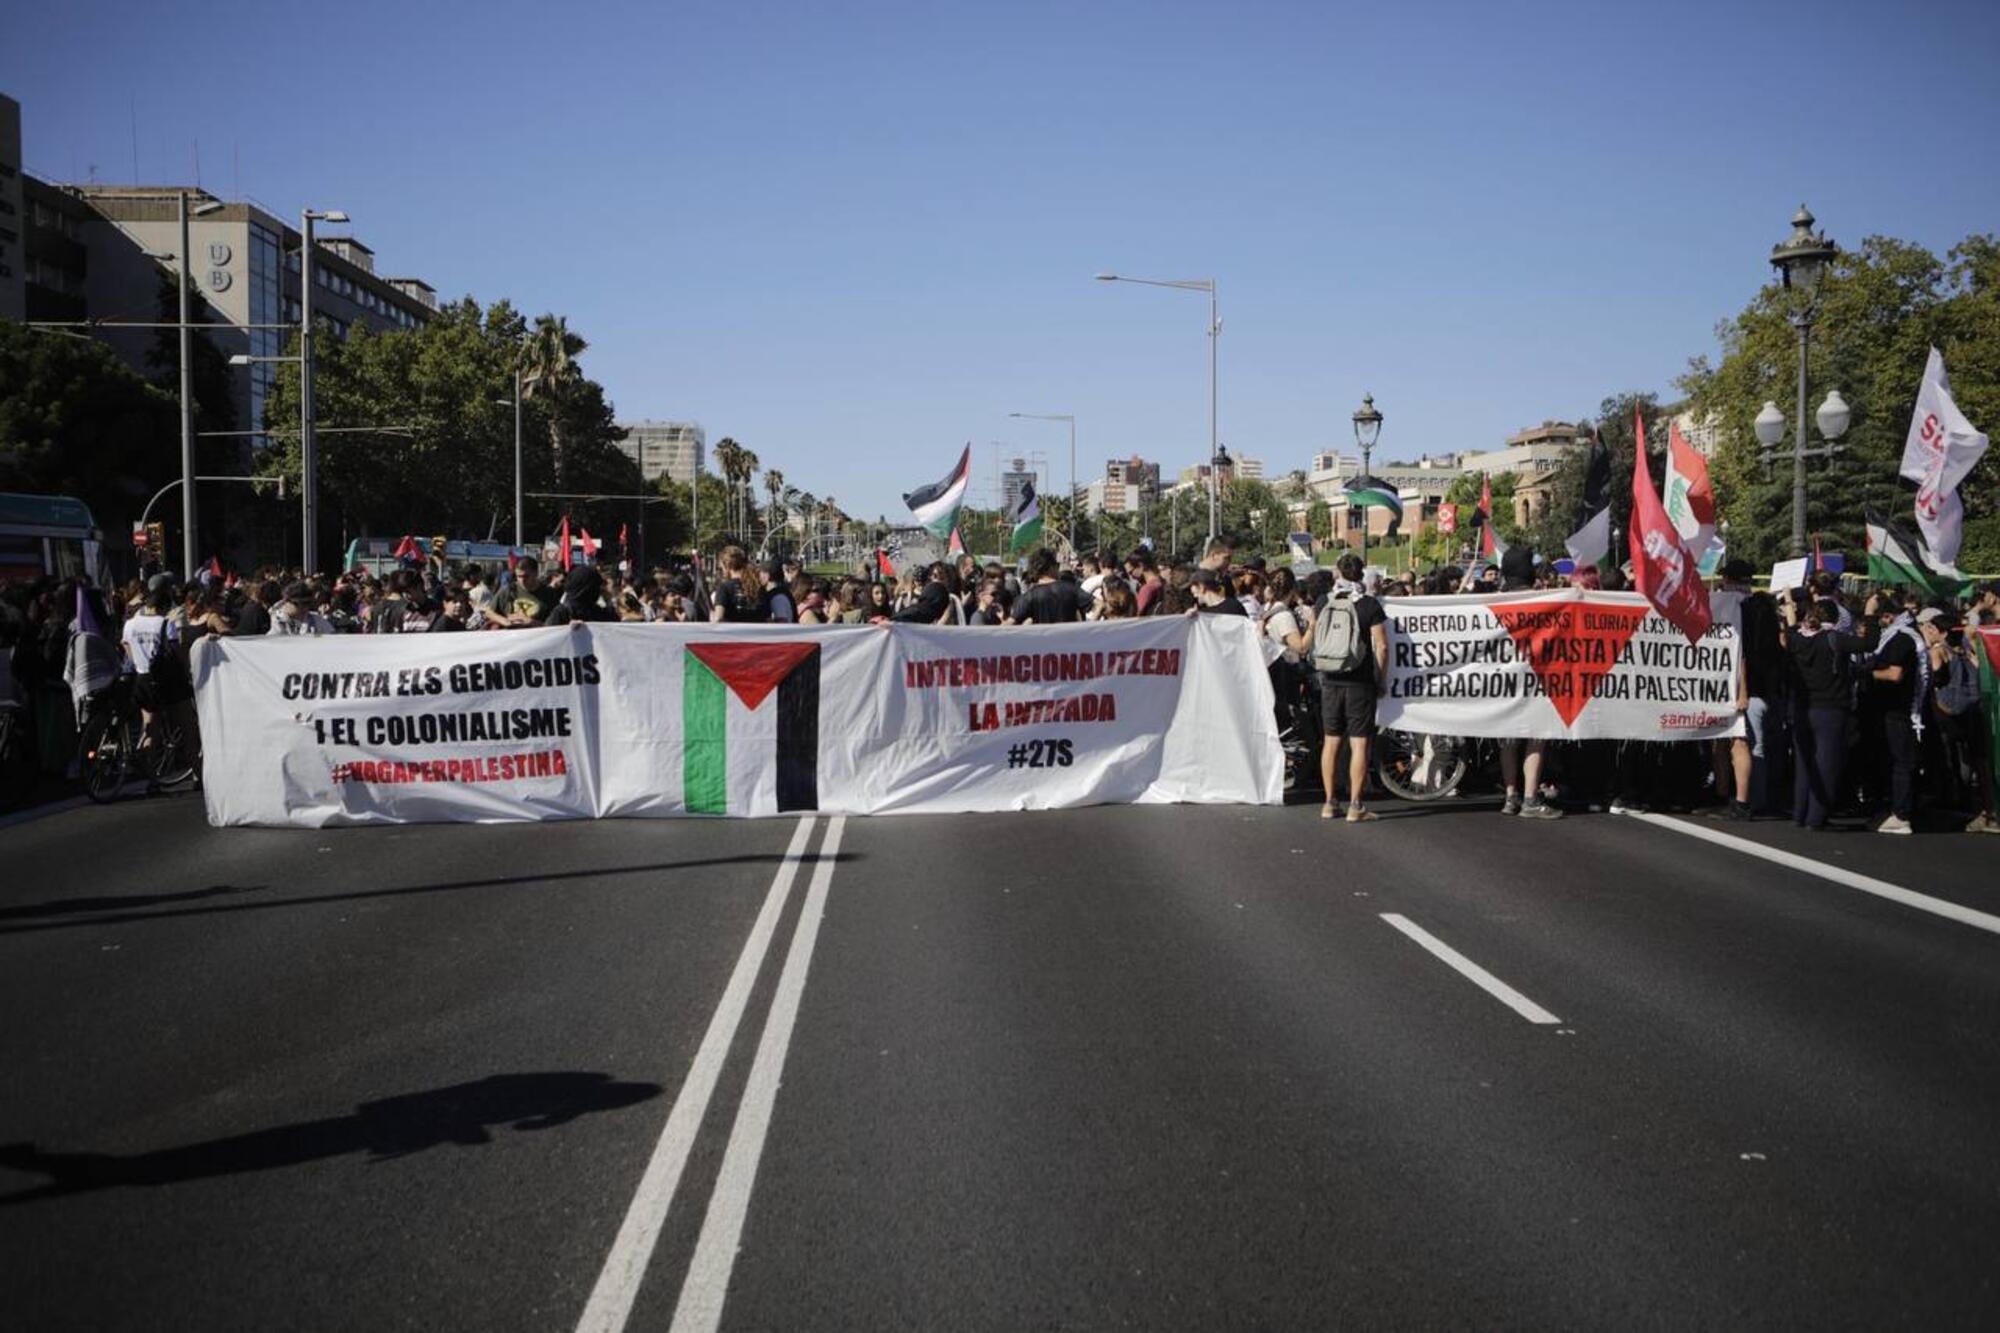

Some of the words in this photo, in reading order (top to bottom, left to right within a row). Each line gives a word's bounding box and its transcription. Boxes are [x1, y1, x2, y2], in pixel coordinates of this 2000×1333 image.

[1394, 614, 1468, 634] LIBERTAD
[1471, 613, 1482, 631] A
[1485, 610, 1514, 630] LXS
[1583, 612, 1630, 631] GLORIA
[1643, 616, 1666, 635] LXS
[1394, 636, 1535, 669] RESISTENCIA
[1612, 640, 1635, 665] LA
[1640, 640, 1732, 673] VICTORIA
[282, 673, 391, 700] CONTRA
[397, 666, 442, 696] ELS
[449, 653, 601, 694] GENOCIDIS
[1390, 668, 1518, 699] LIBERACIÓN
[1523, 671, 1574, 699] PARA
[1580, 671, 1630, 700] TODA
[1634, 674, 1730, 703] PALESTINA
[331, 717, 360, 746] EL
[366, 707, 572, 746] COLONIALISME
[969, 701, 1000, 732] LA
[1004, 693, 1117, 727] INTIFADA
[1007, 738, 1074, 769] #27S
